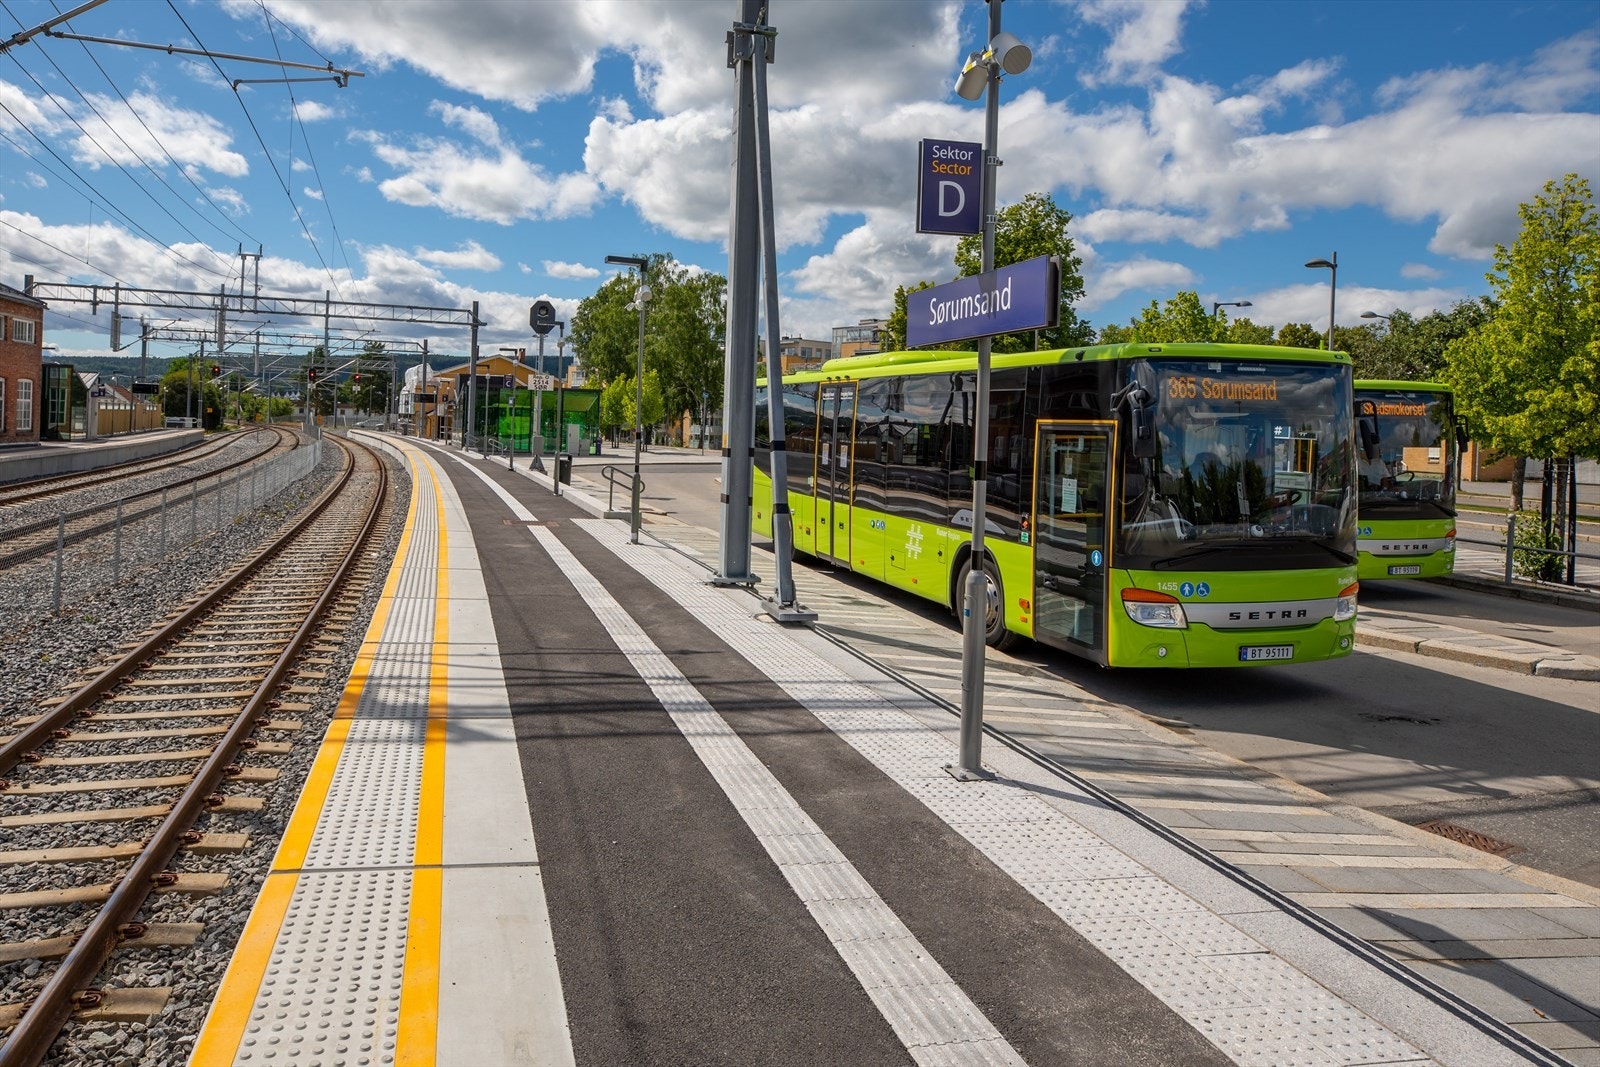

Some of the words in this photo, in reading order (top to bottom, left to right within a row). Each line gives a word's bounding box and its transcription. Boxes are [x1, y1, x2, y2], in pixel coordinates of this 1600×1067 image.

[932, 145, 973, 160] Sektor
[932, 160, 972, 175] Sector
[938, 180, 965, 217] D
[929, 276, 1012, 326] Sørumsand
[1168, 377, 1197, 399] 365
[1201, 377, 1277, 401] Sørumsand
[1157, 582, 1178, 591] 1455
[1229, 609, 1307, 620] SETRA
[1251, 649, 1263, 658] BT
[1265, 647, 1289, 658] 95111
